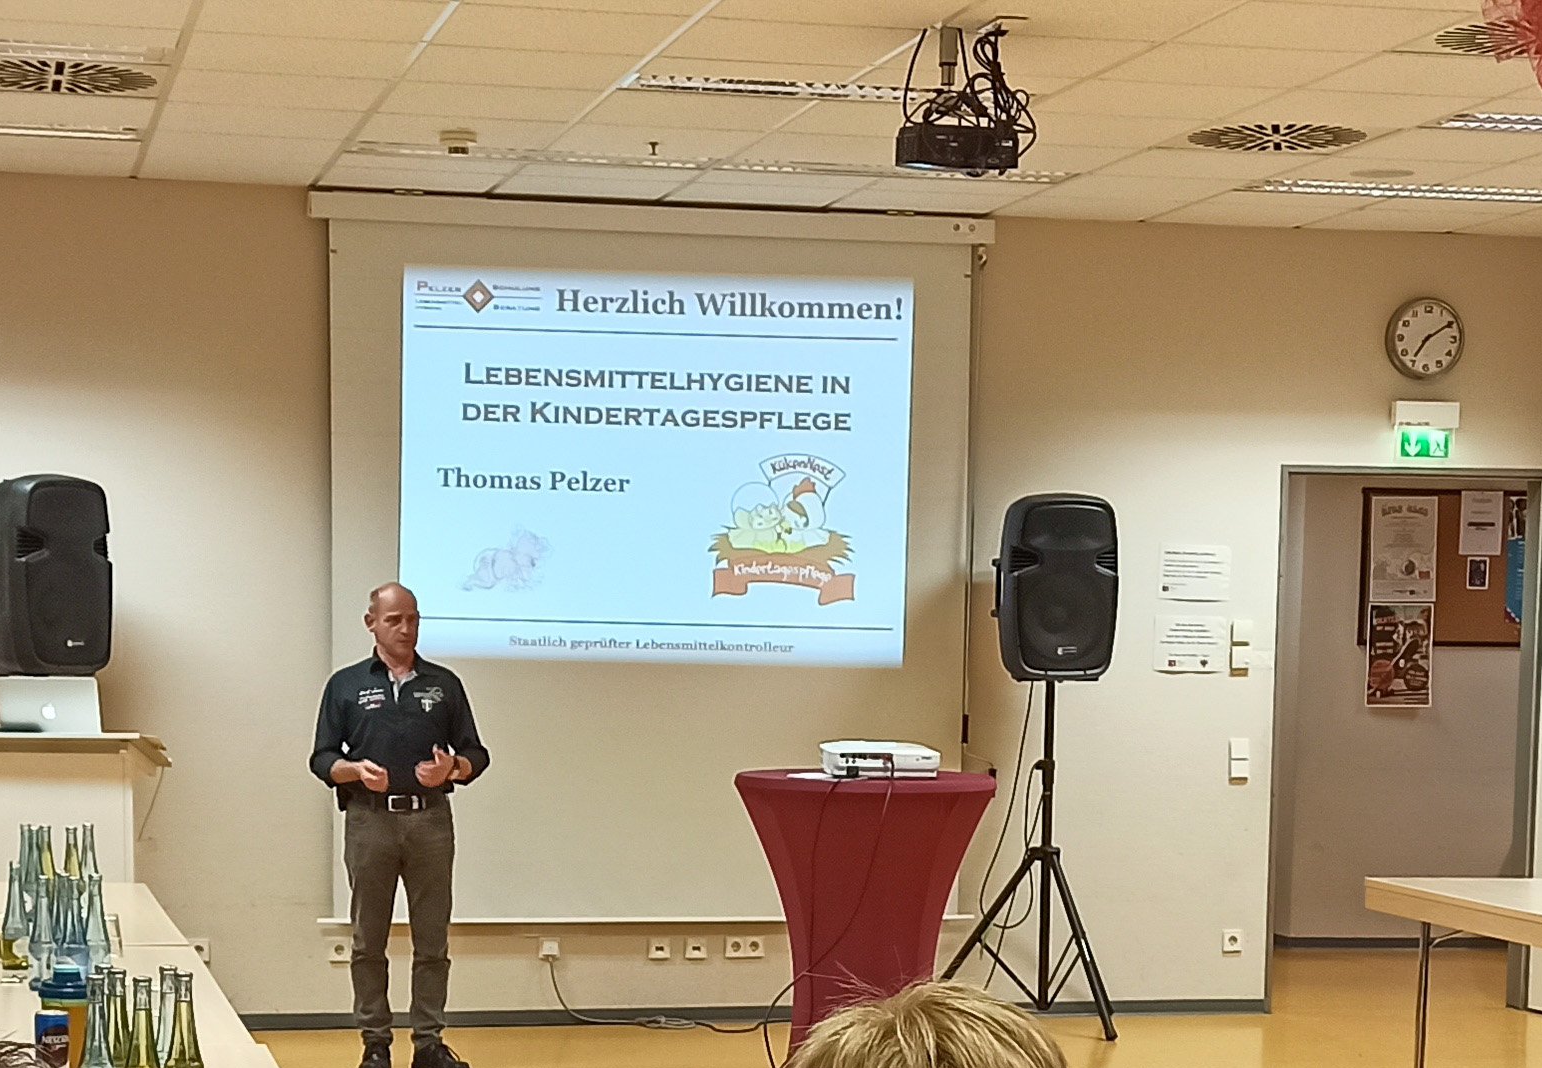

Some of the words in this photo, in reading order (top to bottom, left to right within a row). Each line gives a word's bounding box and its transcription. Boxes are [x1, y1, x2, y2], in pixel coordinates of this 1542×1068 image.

[556, 288, 685, 316] Herzlich
[695, 292, 903, 321] Willkommen!
[1424, 305, 1434, 314] 12
[464, 362, 813, 394] LEBENSMITTELHYGIENE
[822, 375, 851, 394] IN
[462, 403, 521, 423] DER
[530, 401, 852, 432] KINDERTAGESPFLEGE
[437, 467, 542, 490] Thomas
[549, 470, 630, 493] Pelzer
[509, 635, 567, 648] Staatlich
[570, 638, 632, 650] geprüfter
[636, 639, 795, 653] Lebensmittelkontrolleur
